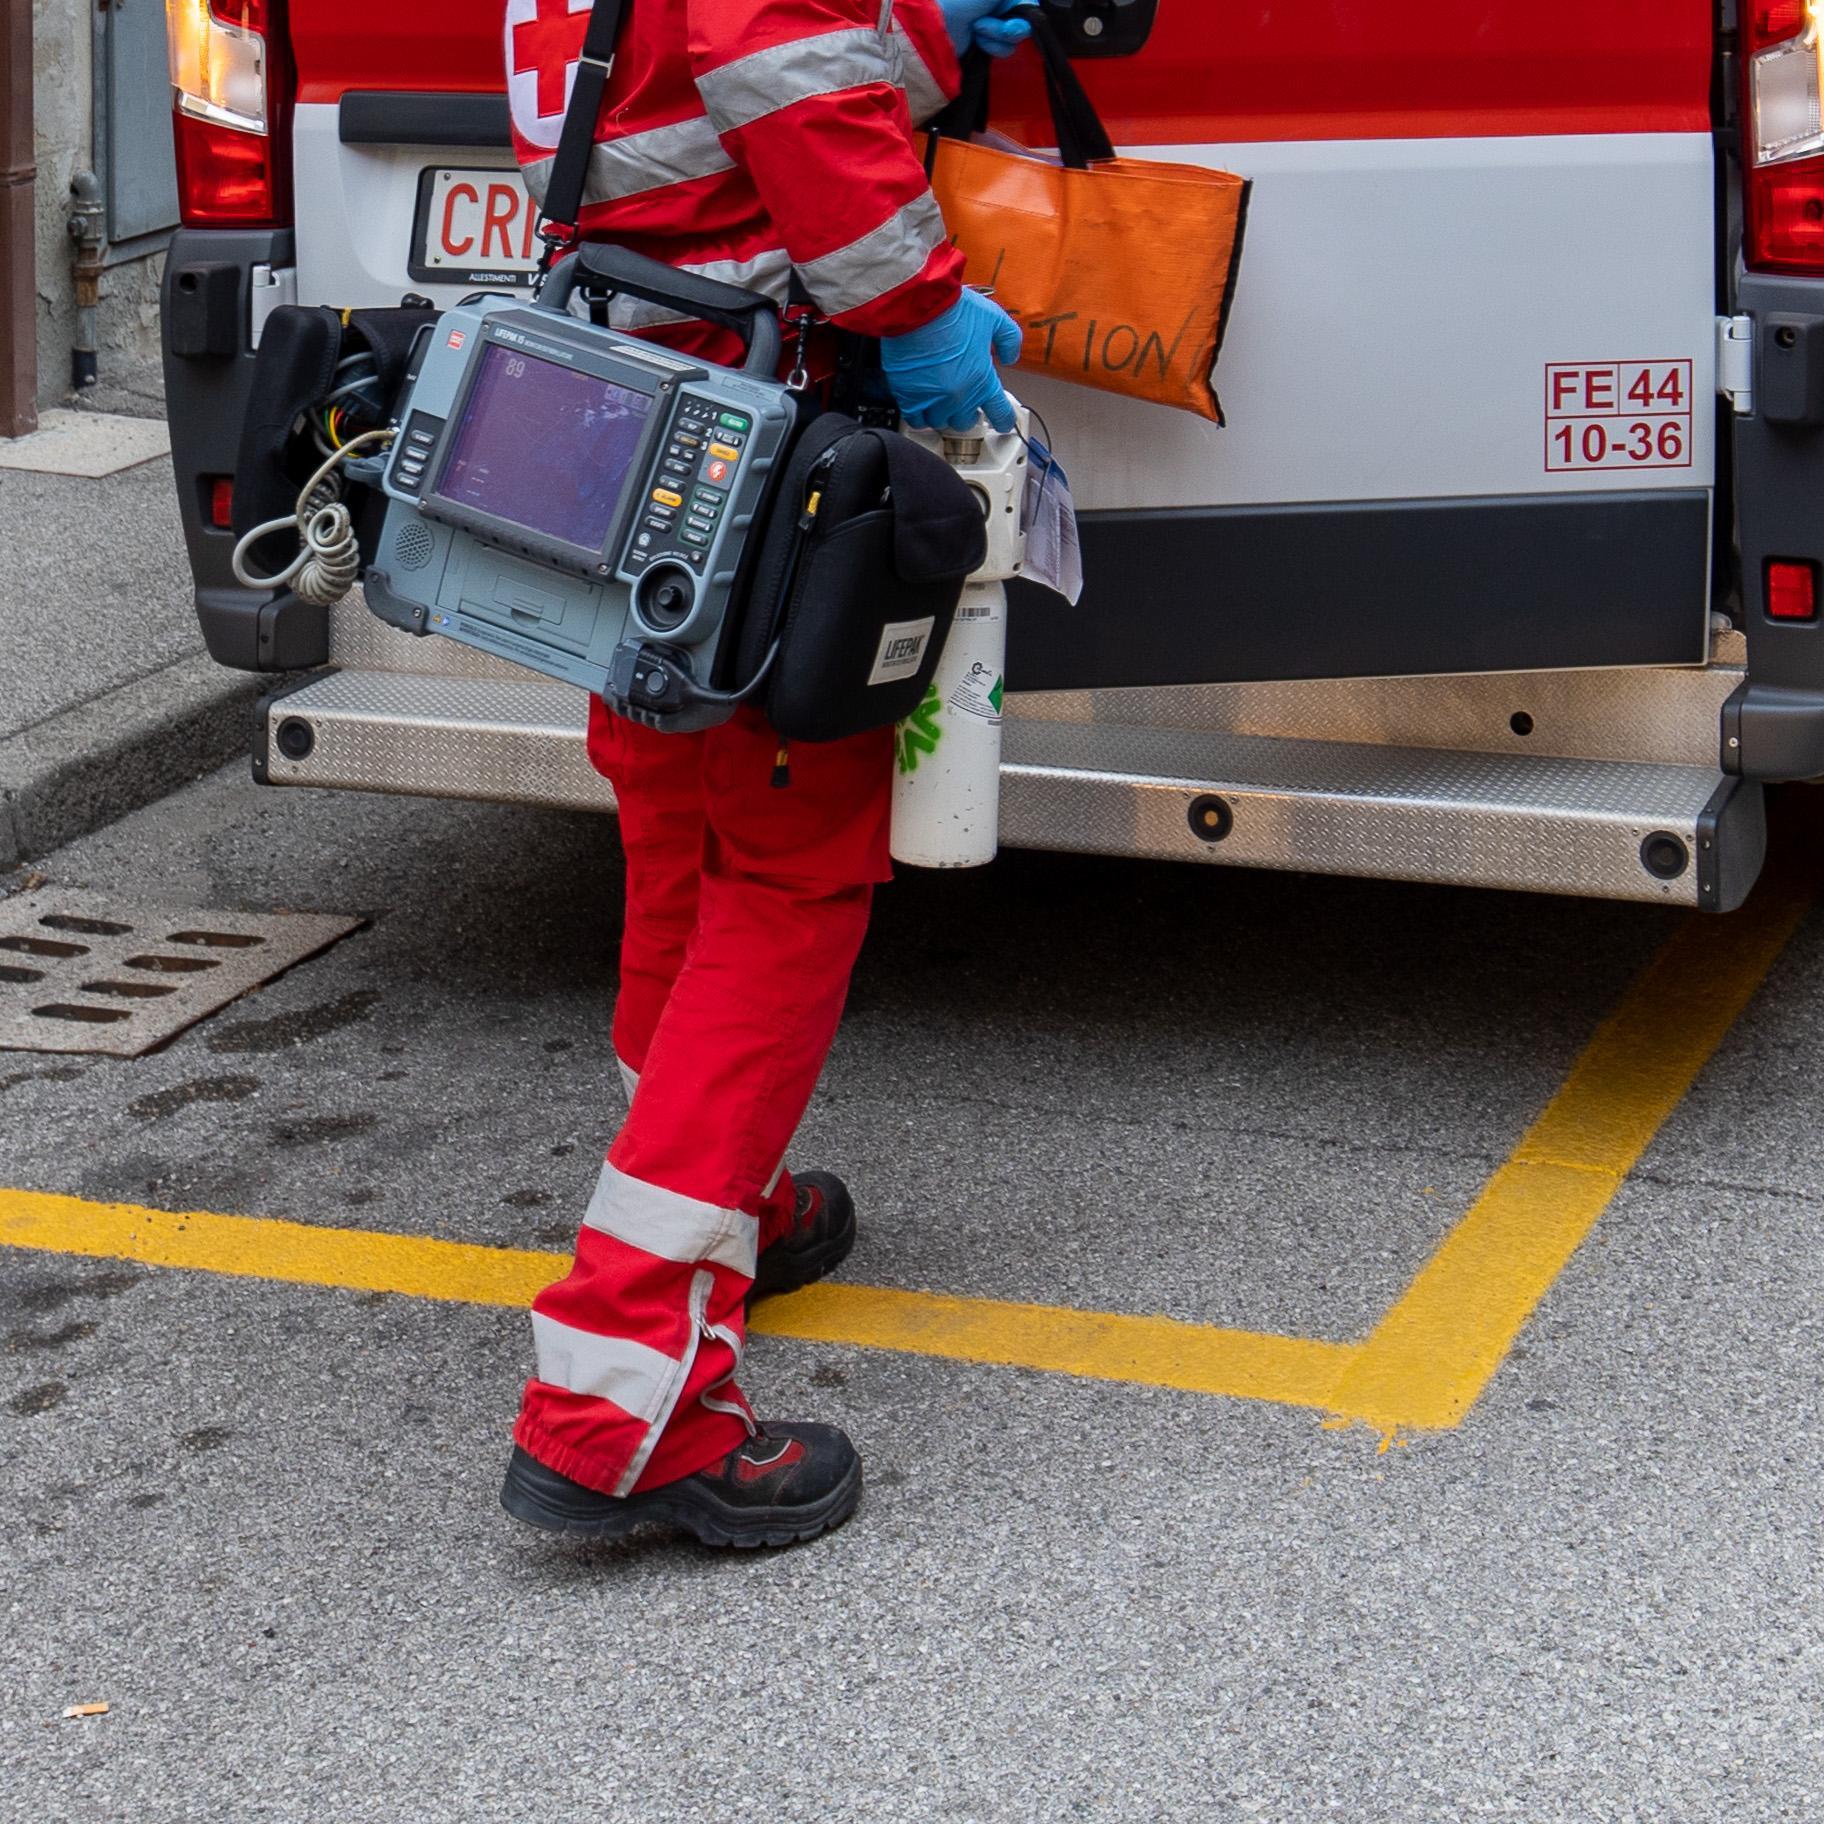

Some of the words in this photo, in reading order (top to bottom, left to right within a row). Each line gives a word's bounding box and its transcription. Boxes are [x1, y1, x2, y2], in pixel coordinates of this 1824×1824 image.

[441, 182, 537, 259] CRI
[505, 358, 526, 379] 89
[1553, 370, 1614, 410] FE
[1628, 367, 1684, 408] 44
[1554, 421, 1683, 463] 10-36
[885, 635, 926, 660] LIFEPAK
